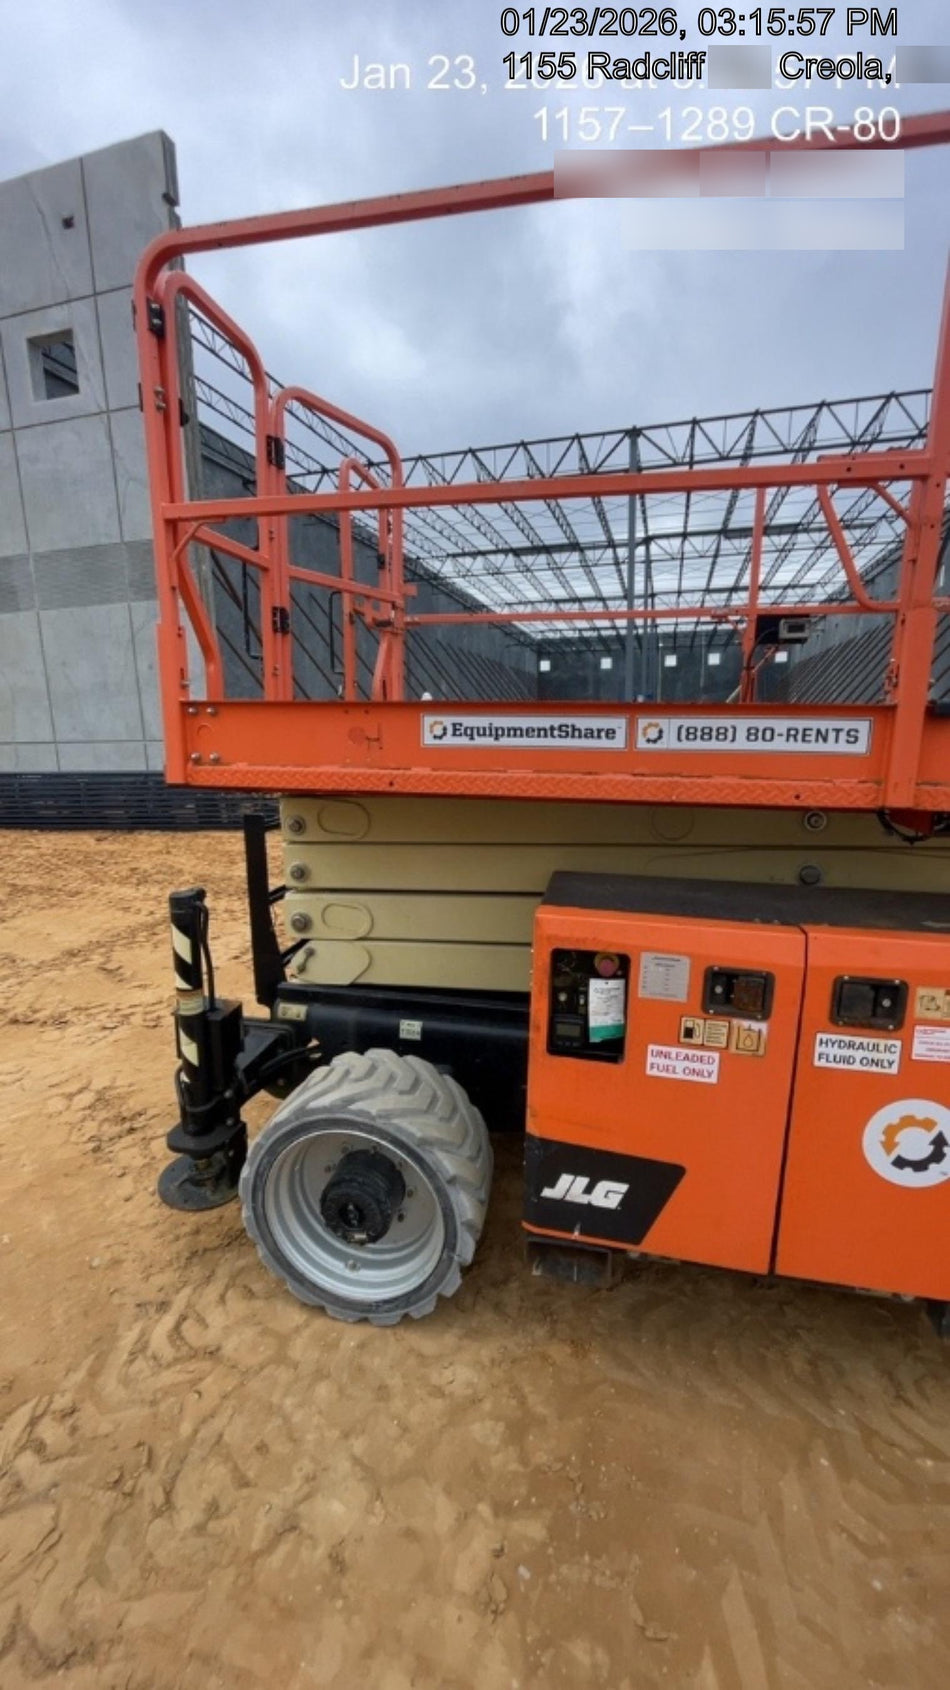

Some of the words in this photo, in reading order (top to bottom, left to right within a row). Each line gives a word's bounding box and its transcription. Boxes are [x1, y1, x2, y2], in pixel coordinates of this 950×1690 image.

[451, 722, 617, 741] EquipmentShare
[676, 724, 737, 743] (888)
[745, 726, 860, 745] 80-RENTS
[818, 1037, 898, 1054] HYDRAULIC
[650, 1048, 716, 1066] UNLEADED
[817, 1052, 857, 1066] FLUID
[859, 1056, 896, 1070] ONLY
[649, 1062, 679, 1075] FUEL
[682, 1066, 714, 1079] ONLY
[540, 1173, 630, 1210] JLG
